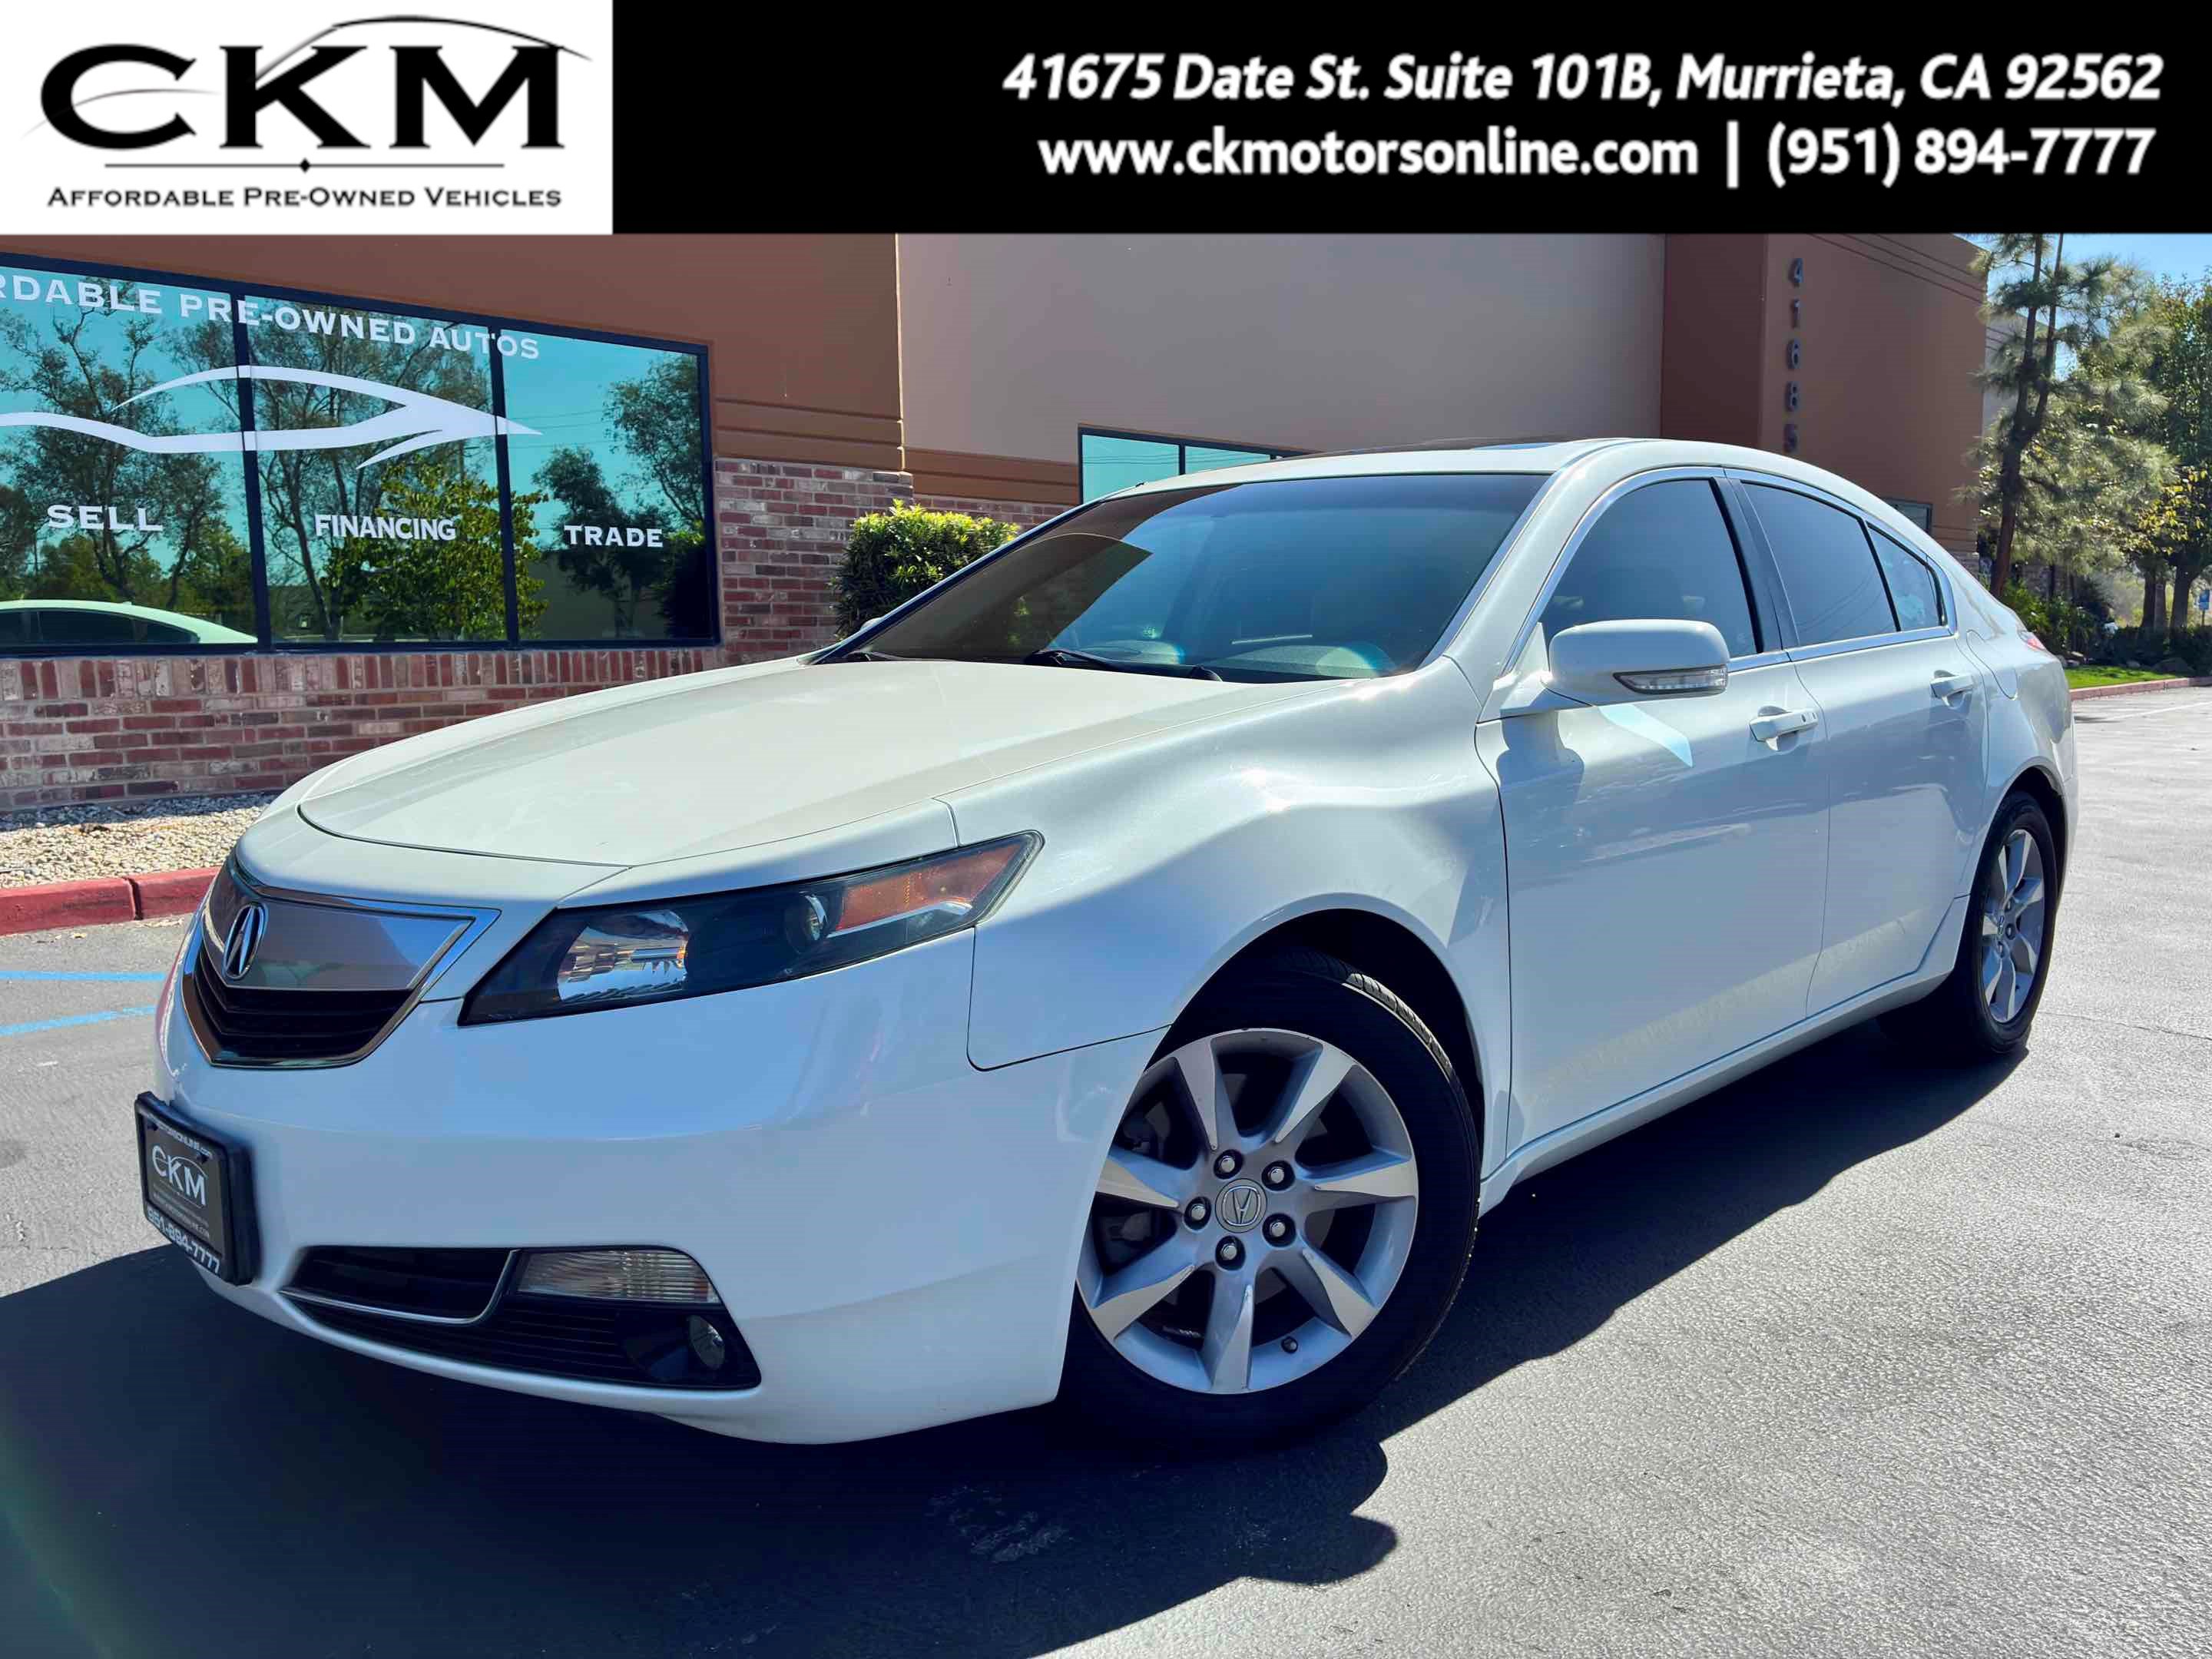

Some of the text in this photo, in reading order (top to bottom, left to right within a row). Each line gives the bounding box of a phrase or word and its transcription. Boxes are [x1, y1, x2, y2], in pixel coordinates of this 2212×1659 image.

[0, 275, 540, 360] DABLE PRE-OWNED AUTOS
[47, 504, 163, 532] SELL
[314, 514, 457, 541] FINANCING
[564, 524, 664, 548] TRADE
[152, 1145, 207, 1206] CKM
